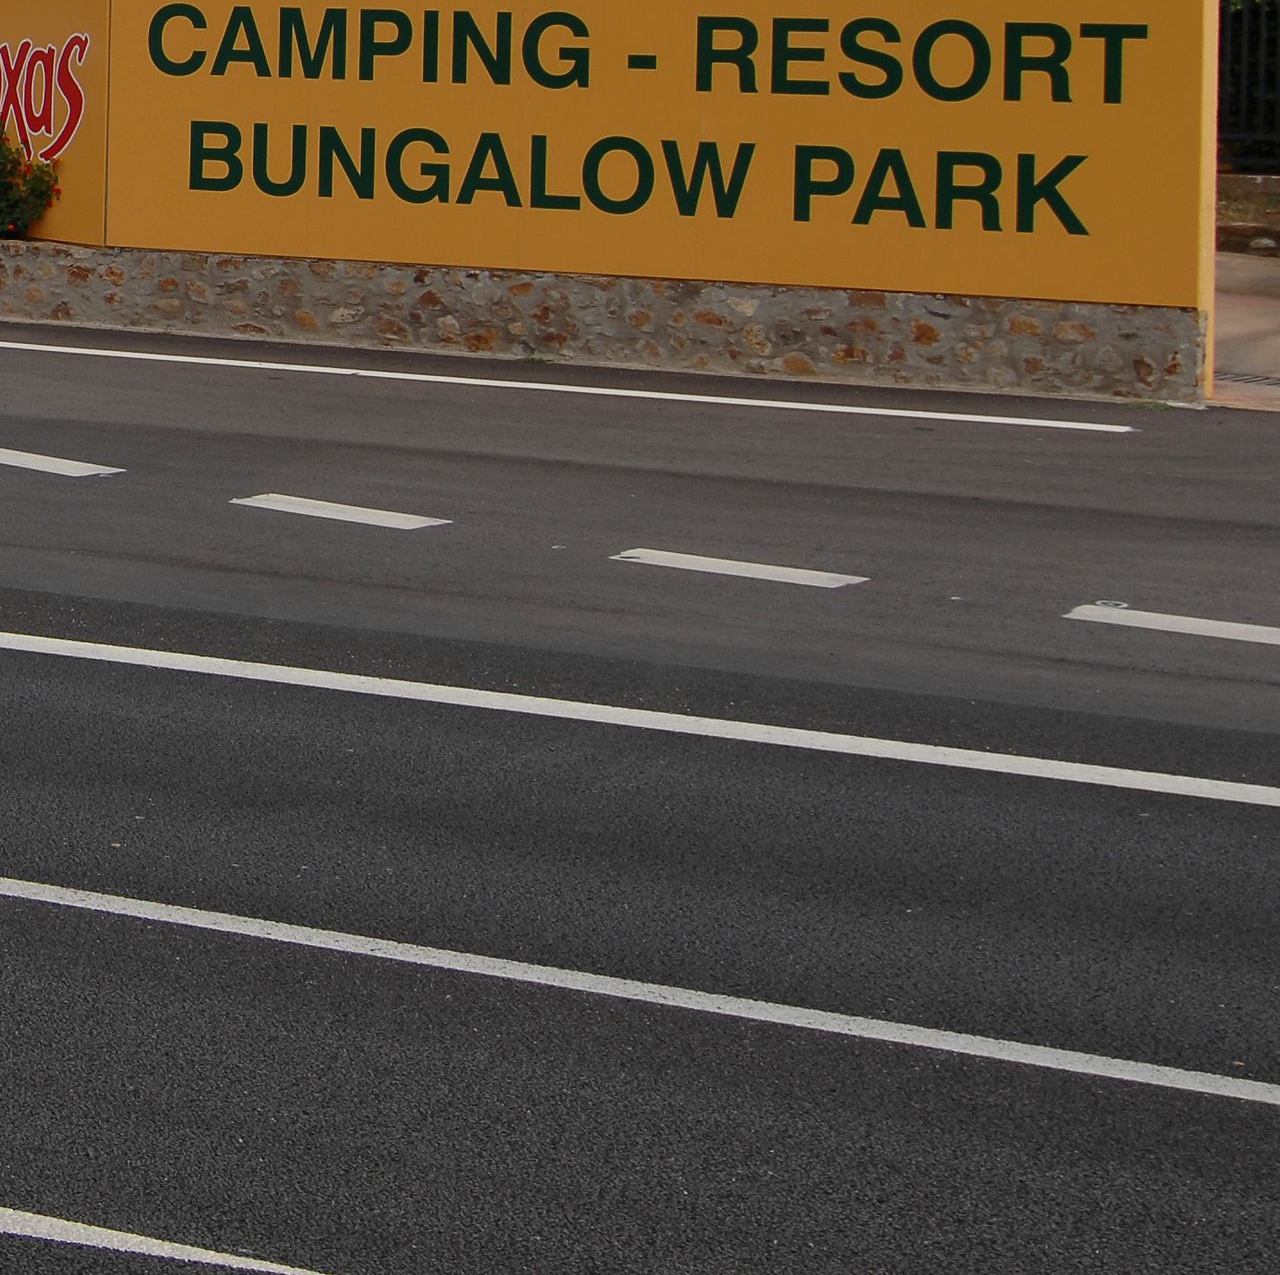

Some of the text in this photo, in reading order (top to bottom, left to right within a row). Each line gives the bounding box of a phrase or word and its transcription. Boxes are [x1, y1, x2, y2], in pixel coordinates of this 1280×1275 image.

[147, 2, 591, 89] CAMPING
[695, 16, 1149, 105] RESORT
[188, 120, 1091, 237] BUNGALOW PARK
